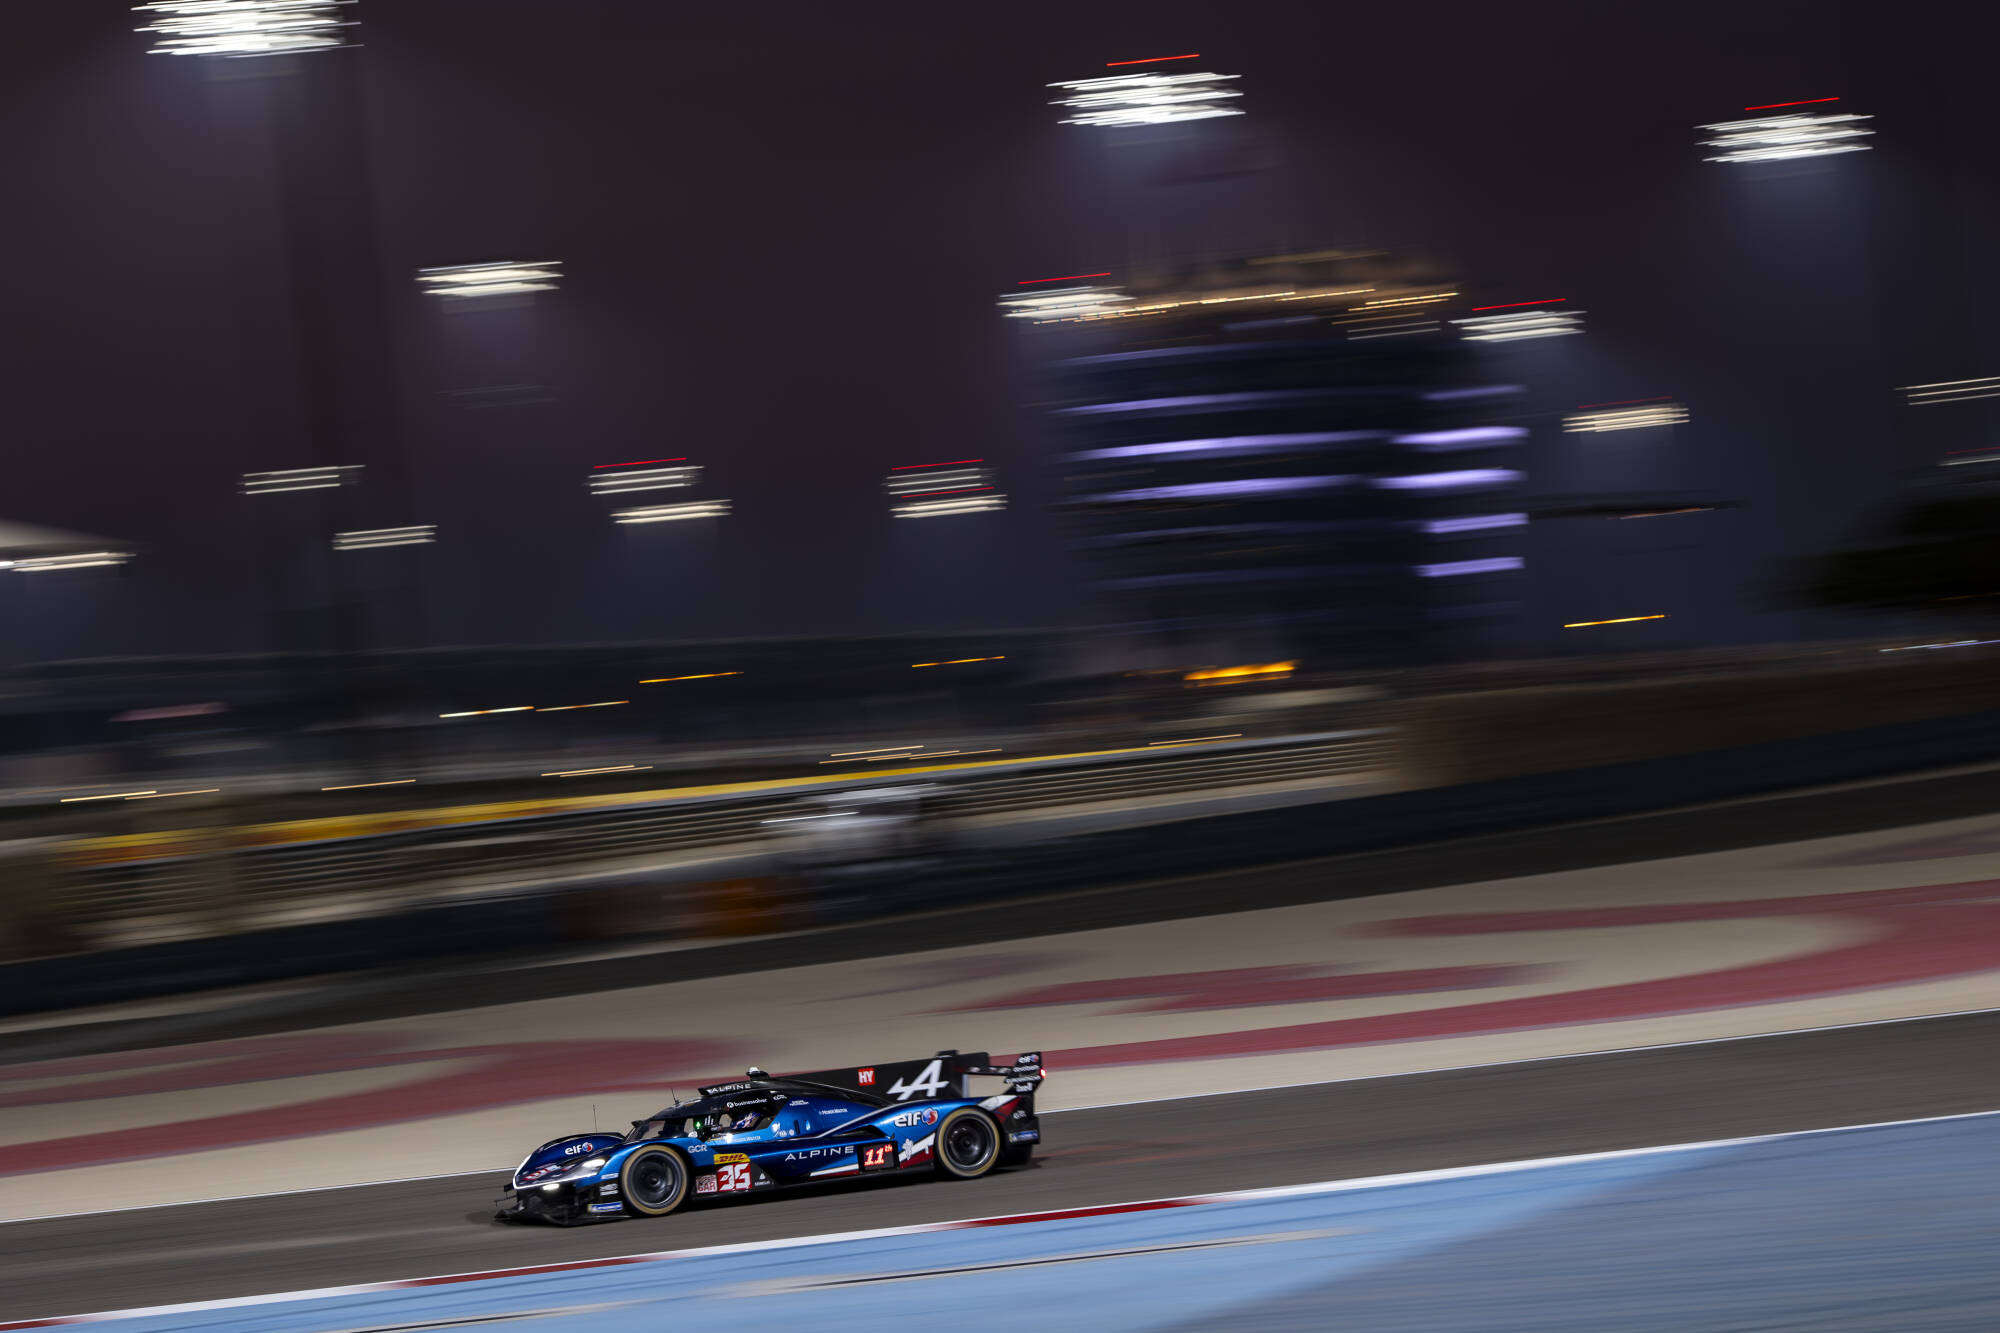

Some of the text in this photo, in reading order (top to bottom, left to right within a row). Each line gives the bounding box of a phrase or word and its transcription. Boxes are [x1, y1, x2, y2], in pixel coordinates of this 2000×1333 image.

[858, 1070, 874, 1084] HY
[711, 1083, 751, 1095] ALPINE
[894, 1111, 922, 1127] elf
[564, 1145, 583, 1155] elf
[687, 1144, 708, 1153] GCR
[784, 1145, 855, 1162] ALPINE
[719, 1154, 745, 1163] DHL
[717, 1163, 750, 1191] 35
